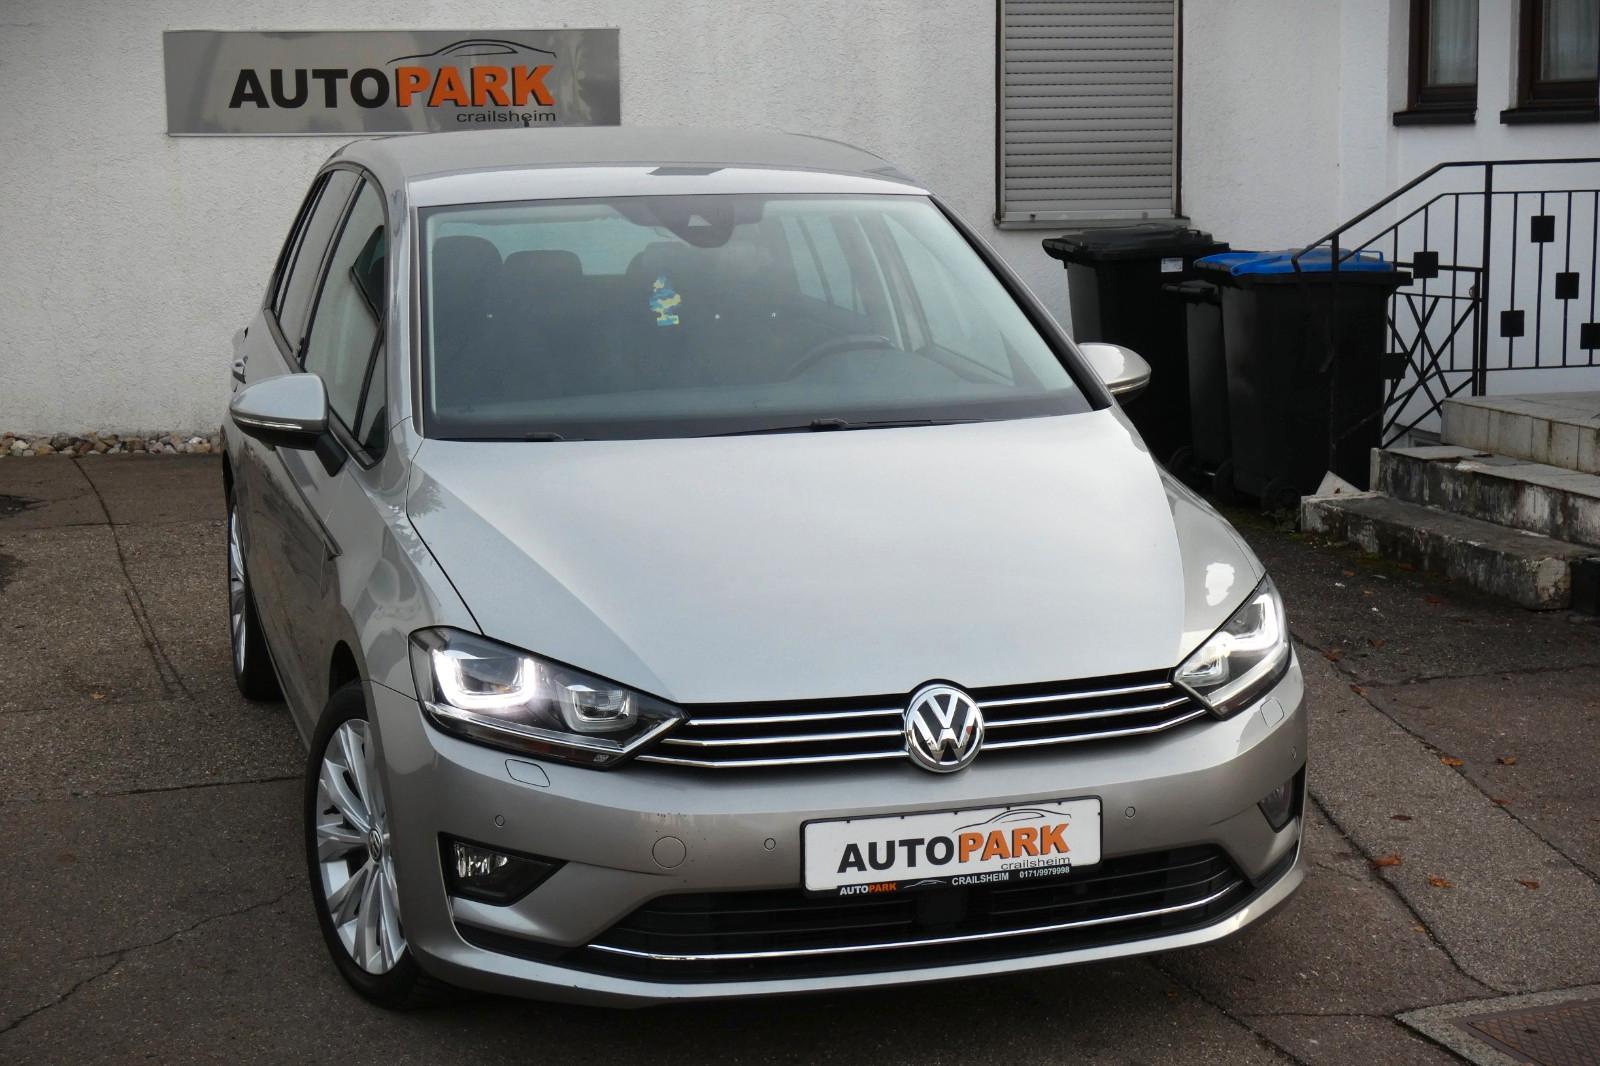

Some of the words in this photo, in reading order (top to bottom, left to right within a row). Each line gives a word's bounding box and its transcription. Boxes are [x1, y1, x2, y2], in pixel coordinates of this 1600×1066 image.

[228, 65, 556, 109] AUTOPARK
[456, 110, 556, 123] crailsheim
[837, 823, 1071, 873] AUTOPARK
[1000, 857, 1071, 871] crailsheim
[951, 872, 1009, 886] CRAILSHEIM
[1019, 865, 1070, 879] 0171/9979998
